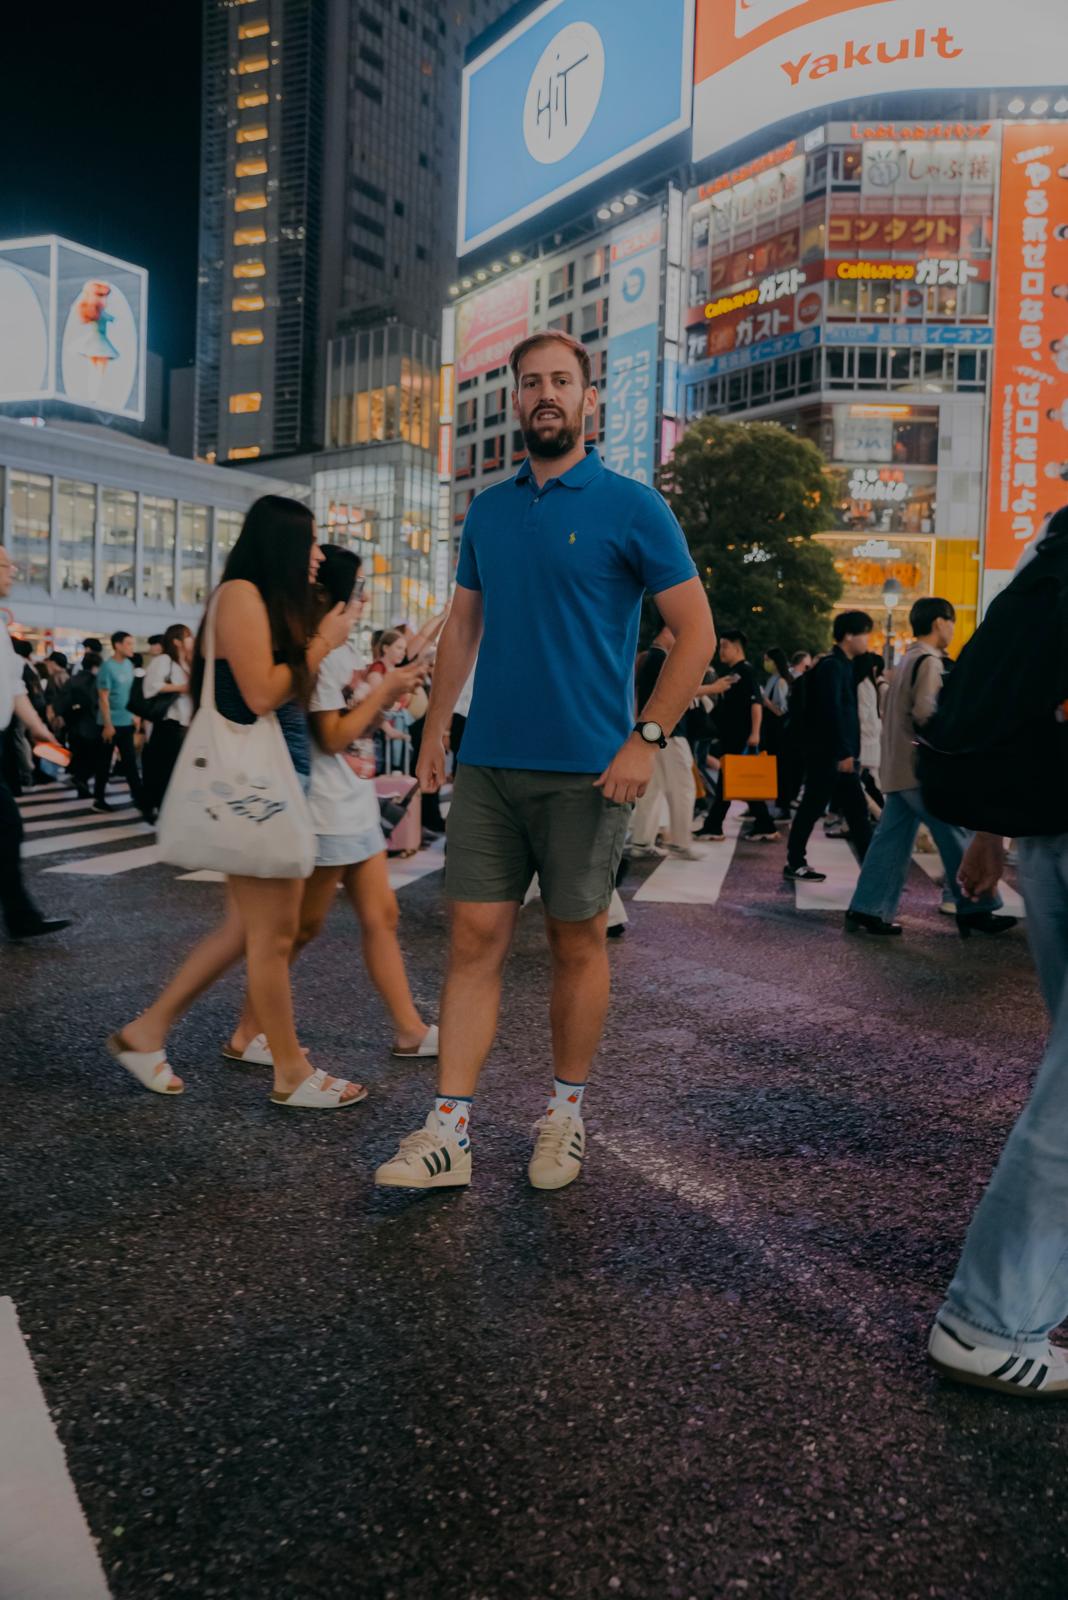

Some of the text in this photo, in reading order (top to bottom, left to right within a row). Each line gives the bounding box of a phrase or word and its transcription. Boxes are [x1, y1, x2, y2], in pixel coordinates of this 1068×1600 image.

[780, 27, 963, 86] Yakult
[829, 217, 957, 244] コンタクト
[758, 267, 807, 305] ガスト
[914, 258, 979, 285] ガスト
[735, 307, 791, 348] ガスト
